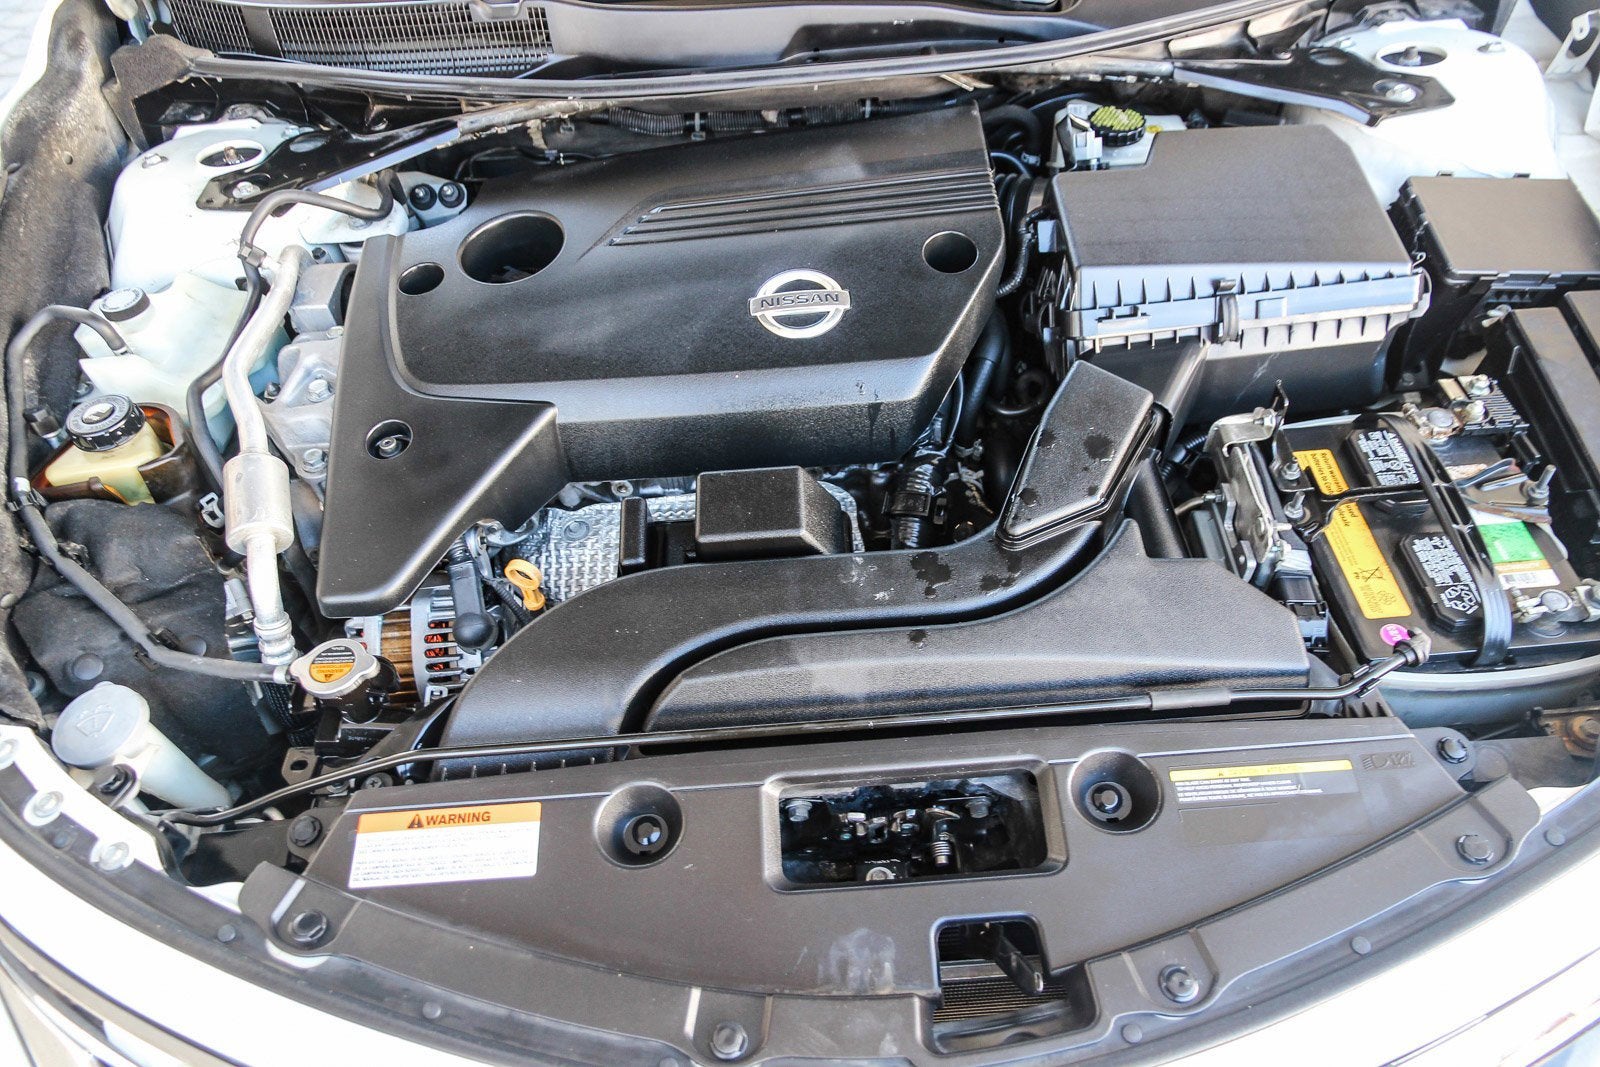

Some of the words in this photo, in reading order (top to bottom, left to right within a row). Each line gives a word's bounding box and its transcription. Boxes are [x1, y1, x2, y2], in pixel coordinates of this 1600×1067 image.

[760, 293, 840, 309] NISSAN
[1346, 504, 1359, 518] used
[426, 811, 491, 826] WARNING
